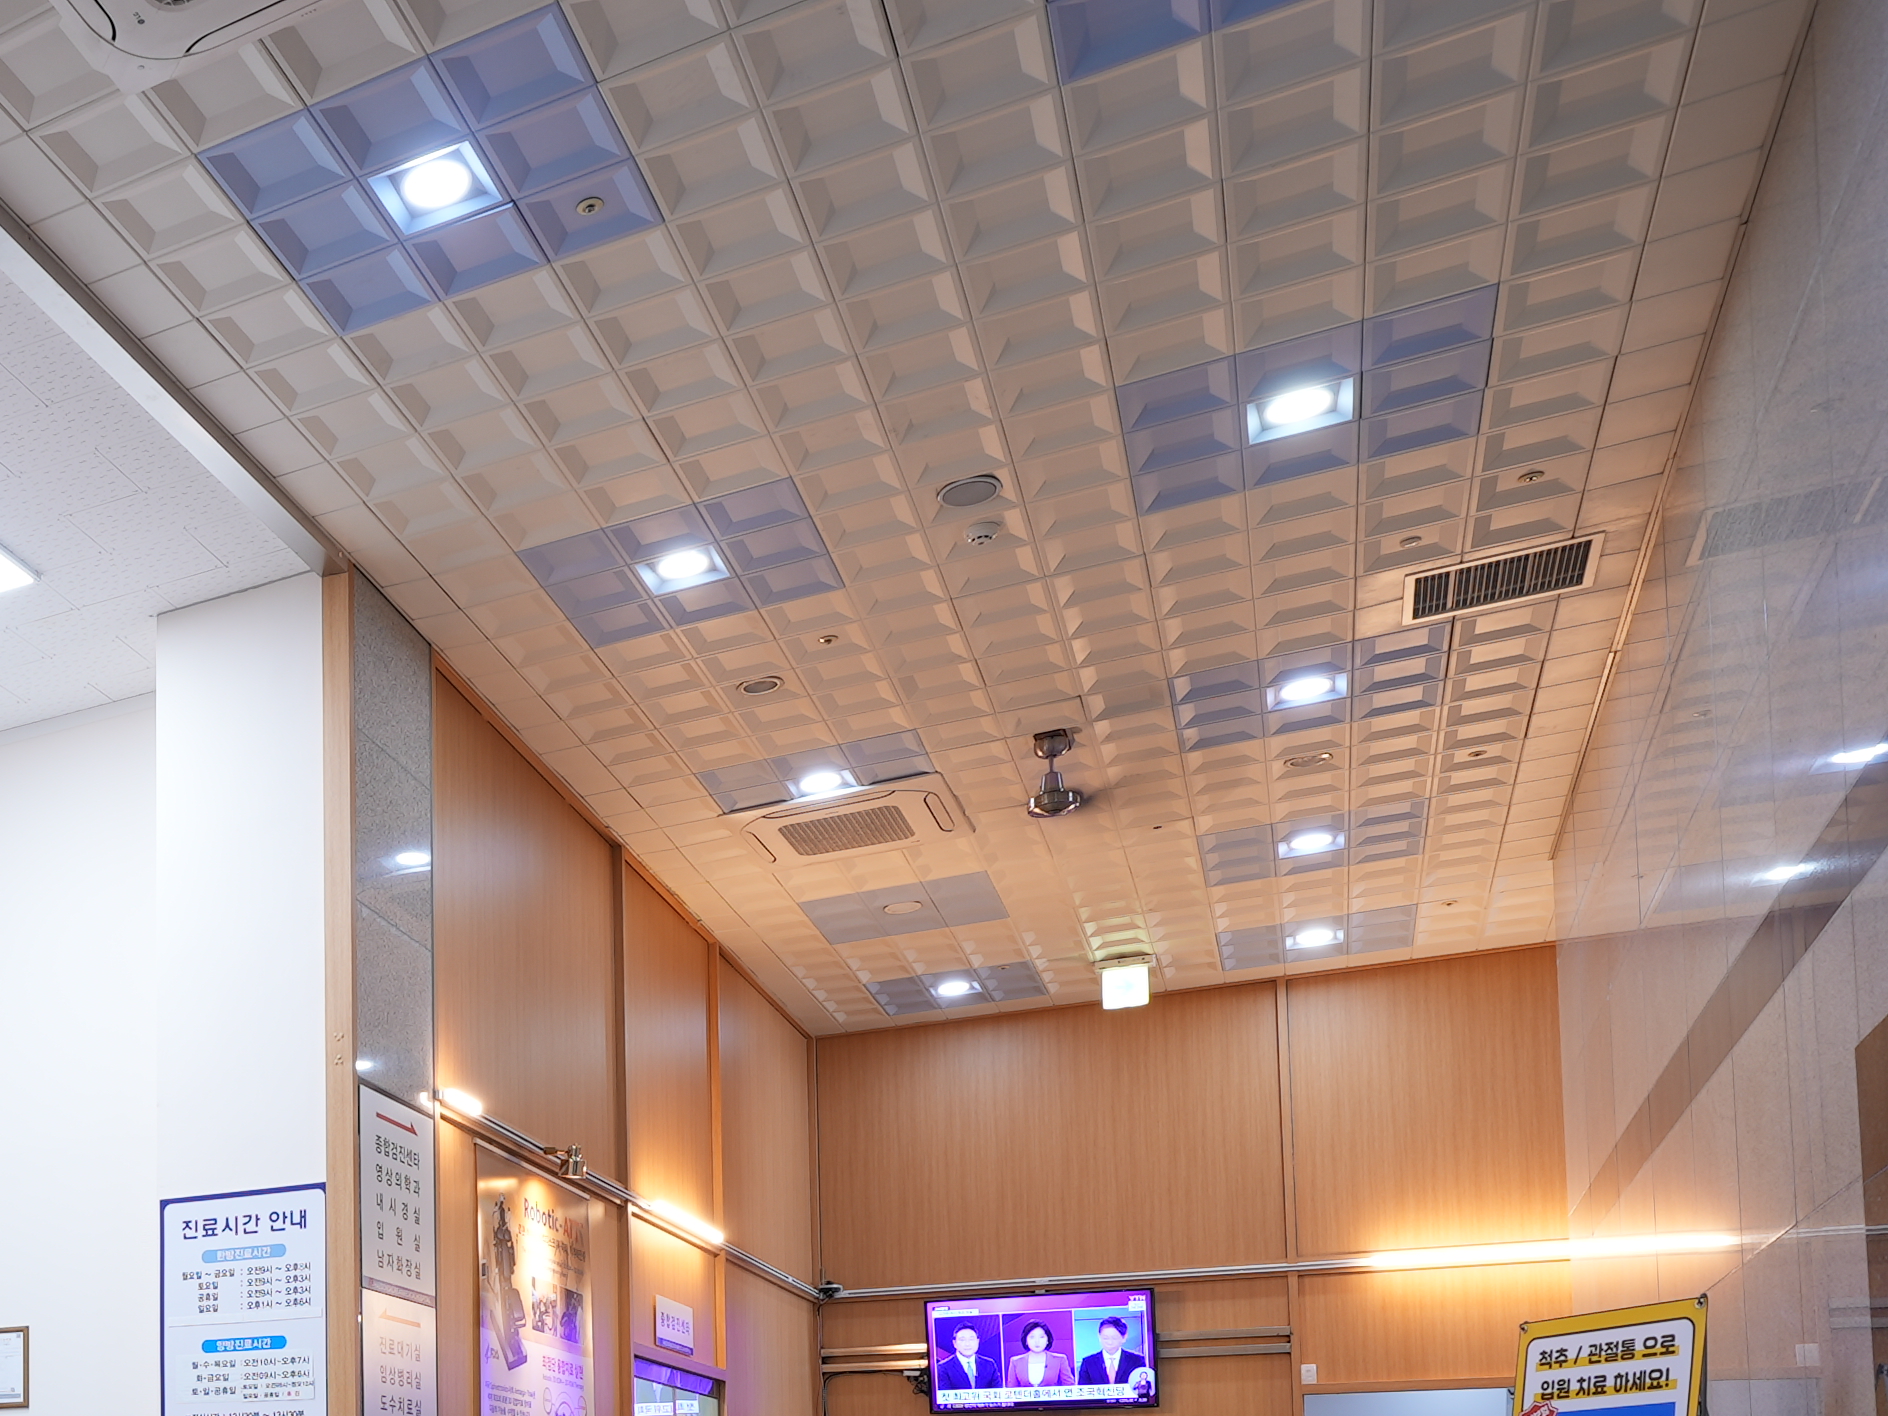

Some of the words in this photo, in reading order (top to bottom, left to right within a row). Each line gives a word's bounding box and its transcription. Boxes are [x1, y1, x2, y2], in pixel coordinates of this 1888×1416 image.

[375, 1134, 420, 1171] 종합검진센터
[375, 1164, 420, 1198] 영상의학과
[182, 1213, 261, 1240] 진료시간
[268, 1209, 307, 1232] 안내
[214, 1268, 235, 1279] 금요일
[377, 1249, 421, 1280] 남자화장실
[198, 1281, 218, 1290] 토요일
[284, 1273, 311, 1284] 오후3시
[198, 1292, 218, 1302] 공휴일
[198, 1304, 218, 1313] 일요일
[1538, 1346, 1568, 1369] 척추
[1588, 1338, 1637, 1365] 관절통
[1642, 1333, 1676, 1358] 으로
[380, 1365, 421, 1390] 임상병리실
[1540, 1378, 1571, 1400] 입원
[1575, 1374, 1608, 1398] 치료
[1613, 1367, 1671, 1394] 하세요!
